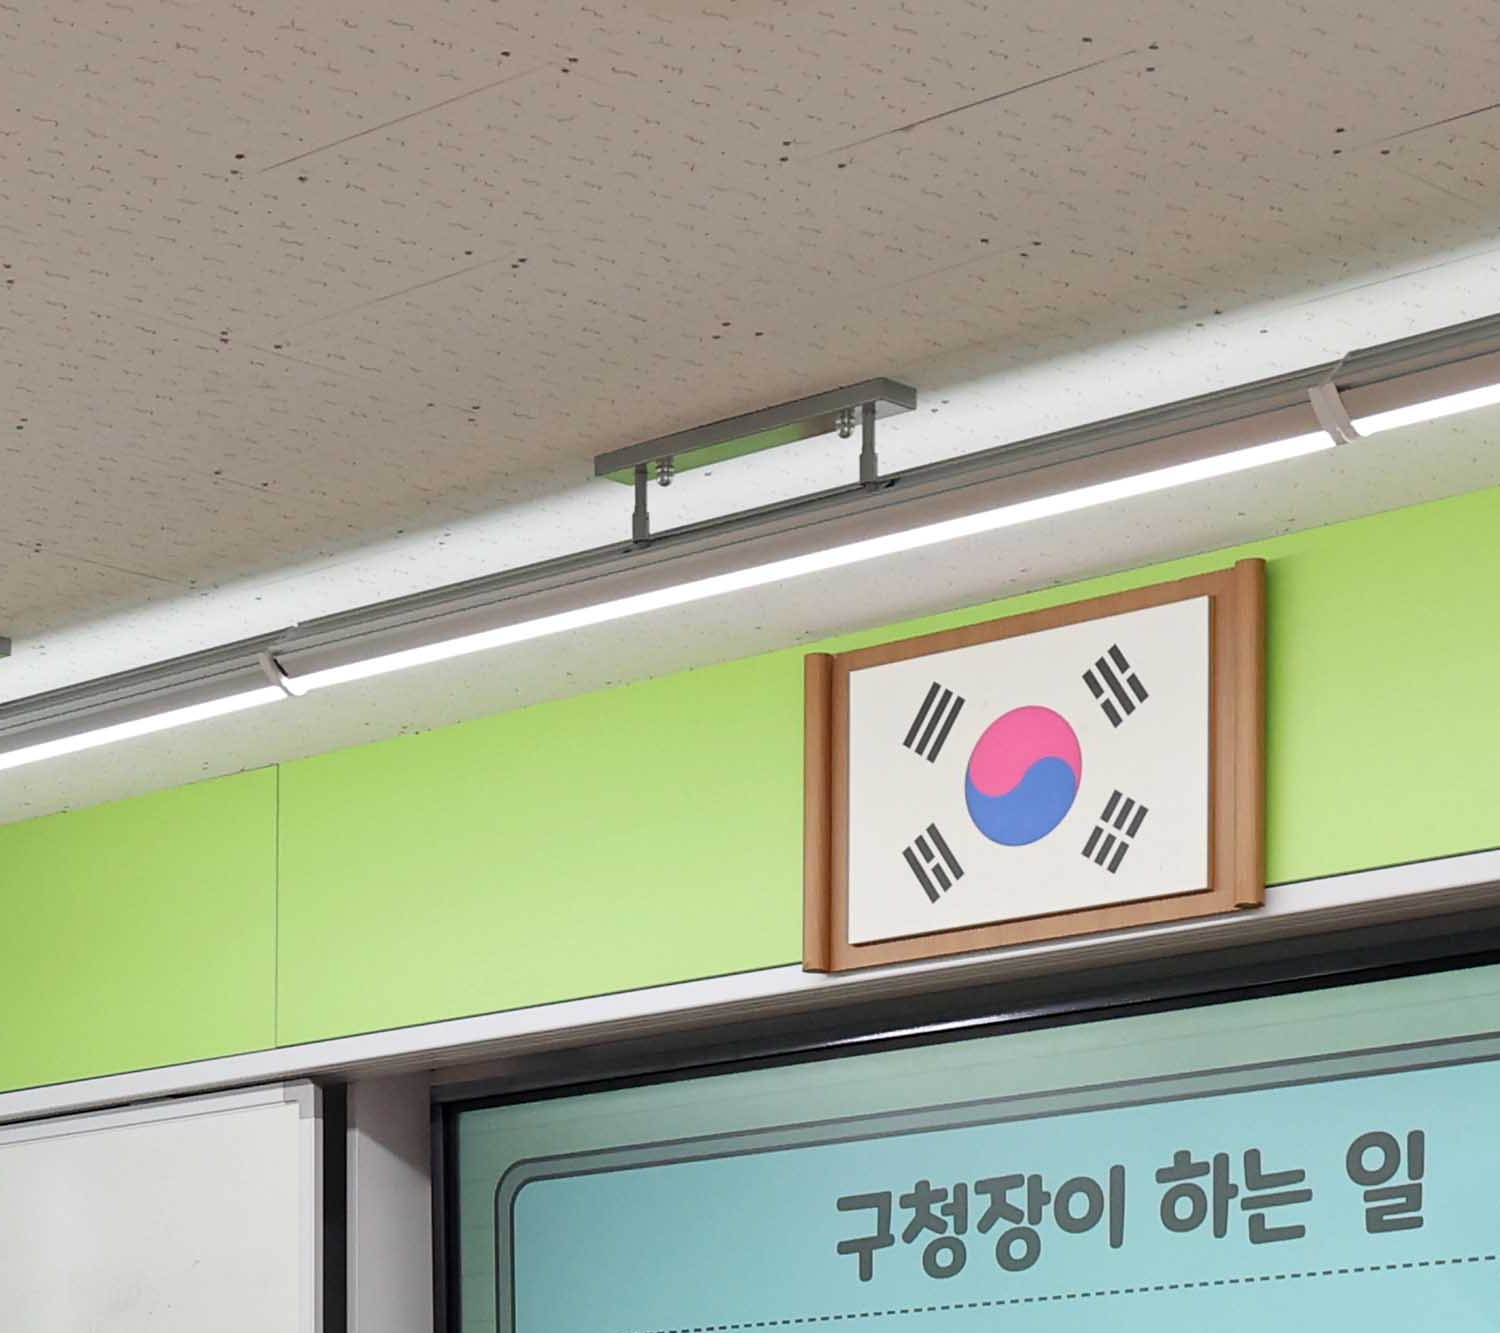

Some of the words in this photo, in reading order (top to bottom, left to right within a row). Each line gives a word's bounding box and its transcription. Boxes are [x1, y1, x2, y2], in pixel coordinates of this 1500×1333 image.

[836, 1164, 1126, 1282] 구청장이
[1154, 1148, 1313, 1245] 하는
[1345, 1129, 1426, 1233] 일
